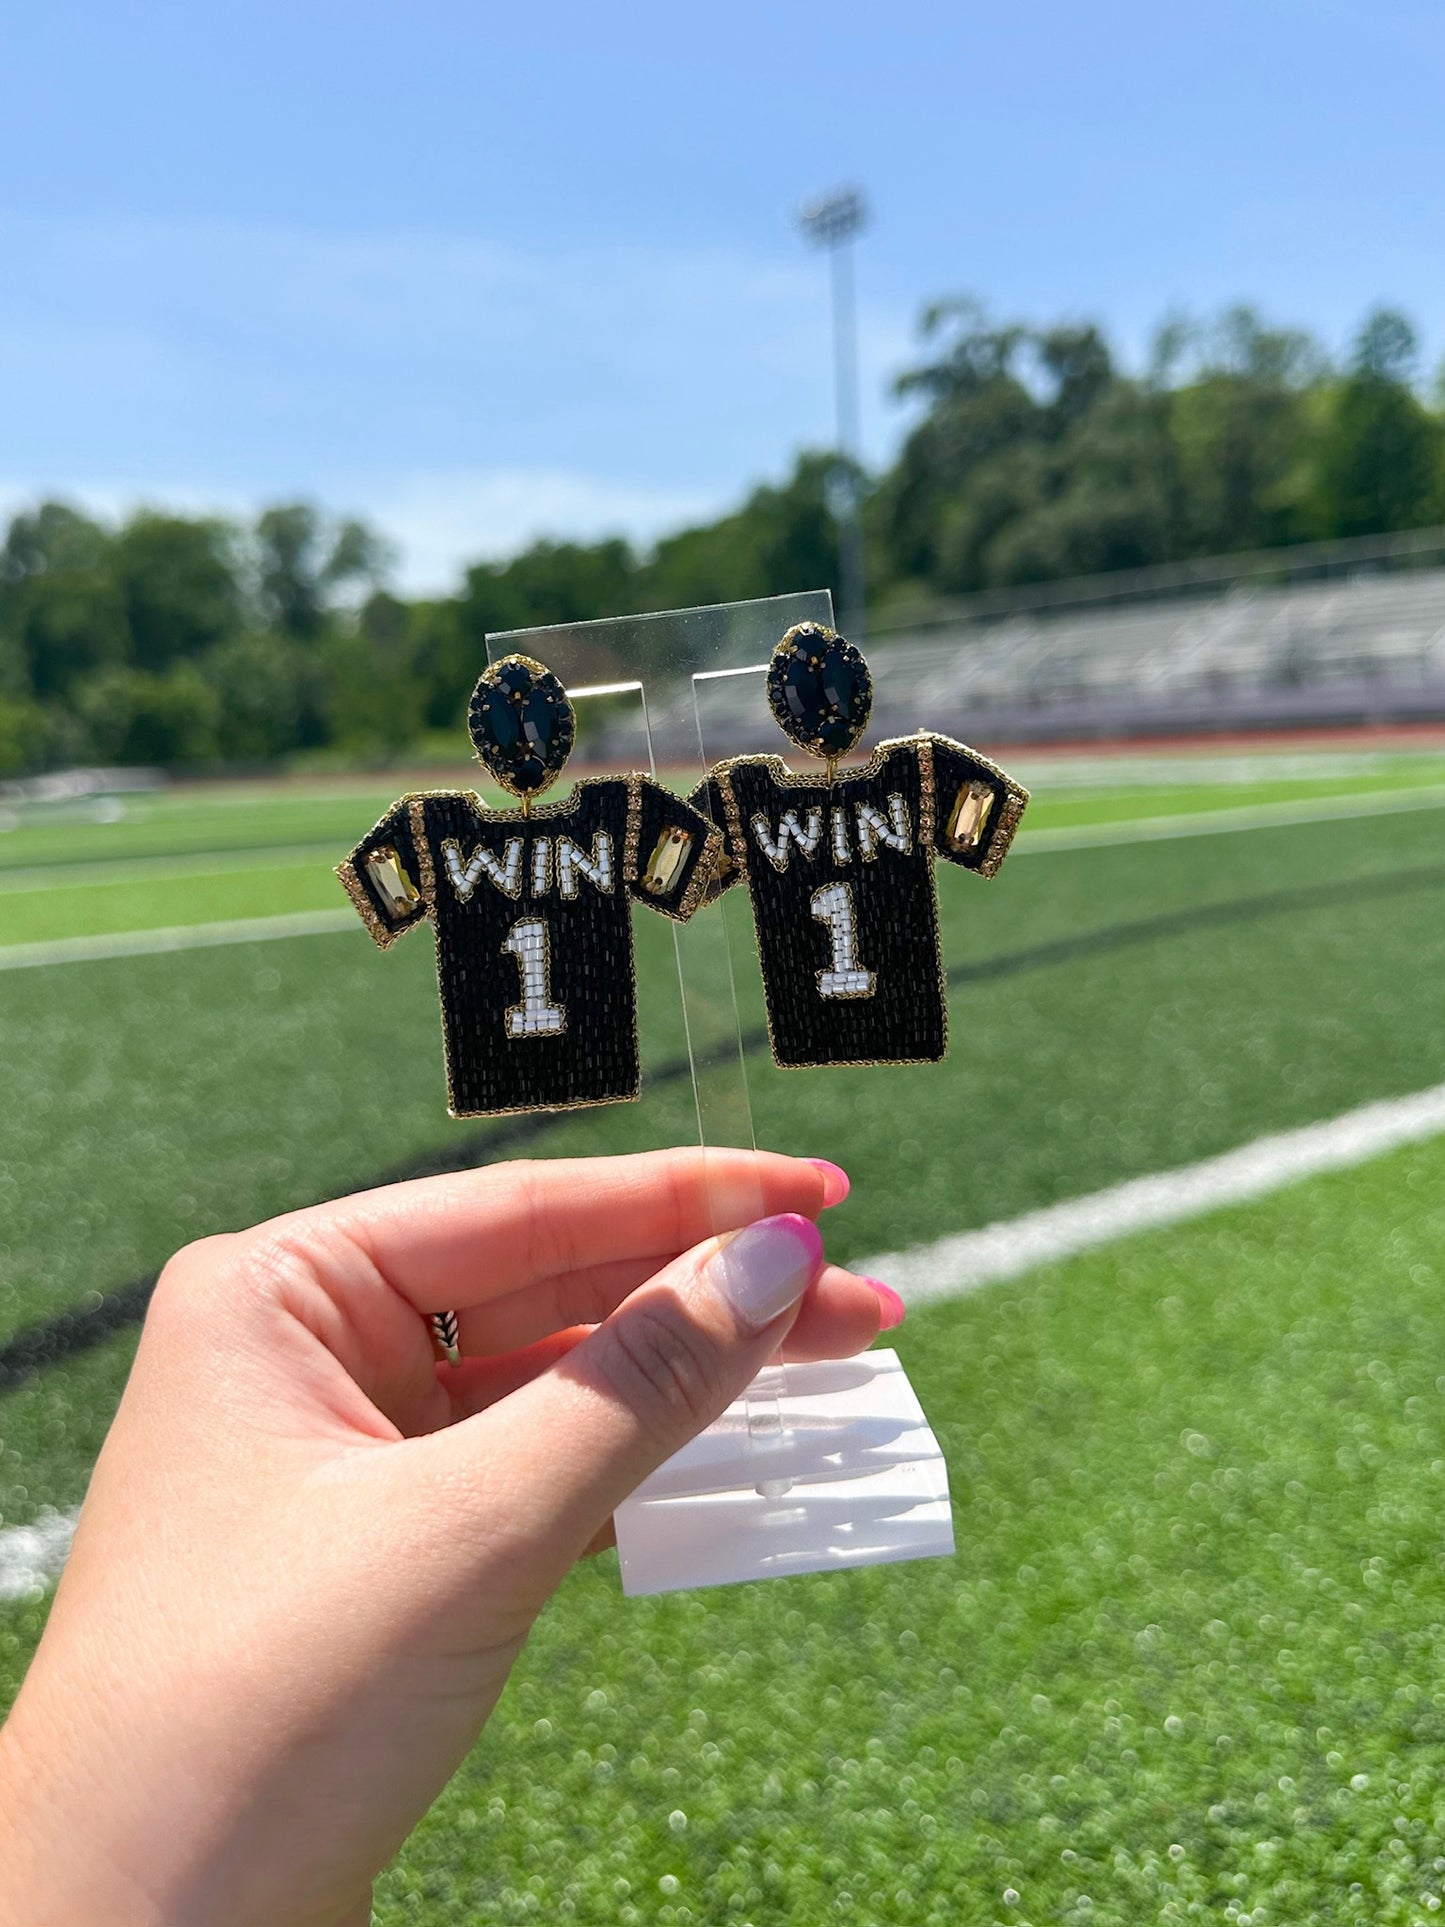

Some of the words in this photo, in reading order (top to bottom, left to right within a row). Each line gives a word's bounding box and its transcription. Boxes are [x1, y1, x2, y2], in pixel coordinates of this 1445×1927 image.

[441, 830, 614, 902] WIN
[750, 793, 912, 871] WIN
[503, 917, 567, 1037] 1
[811, 881, 877, 999] 1
